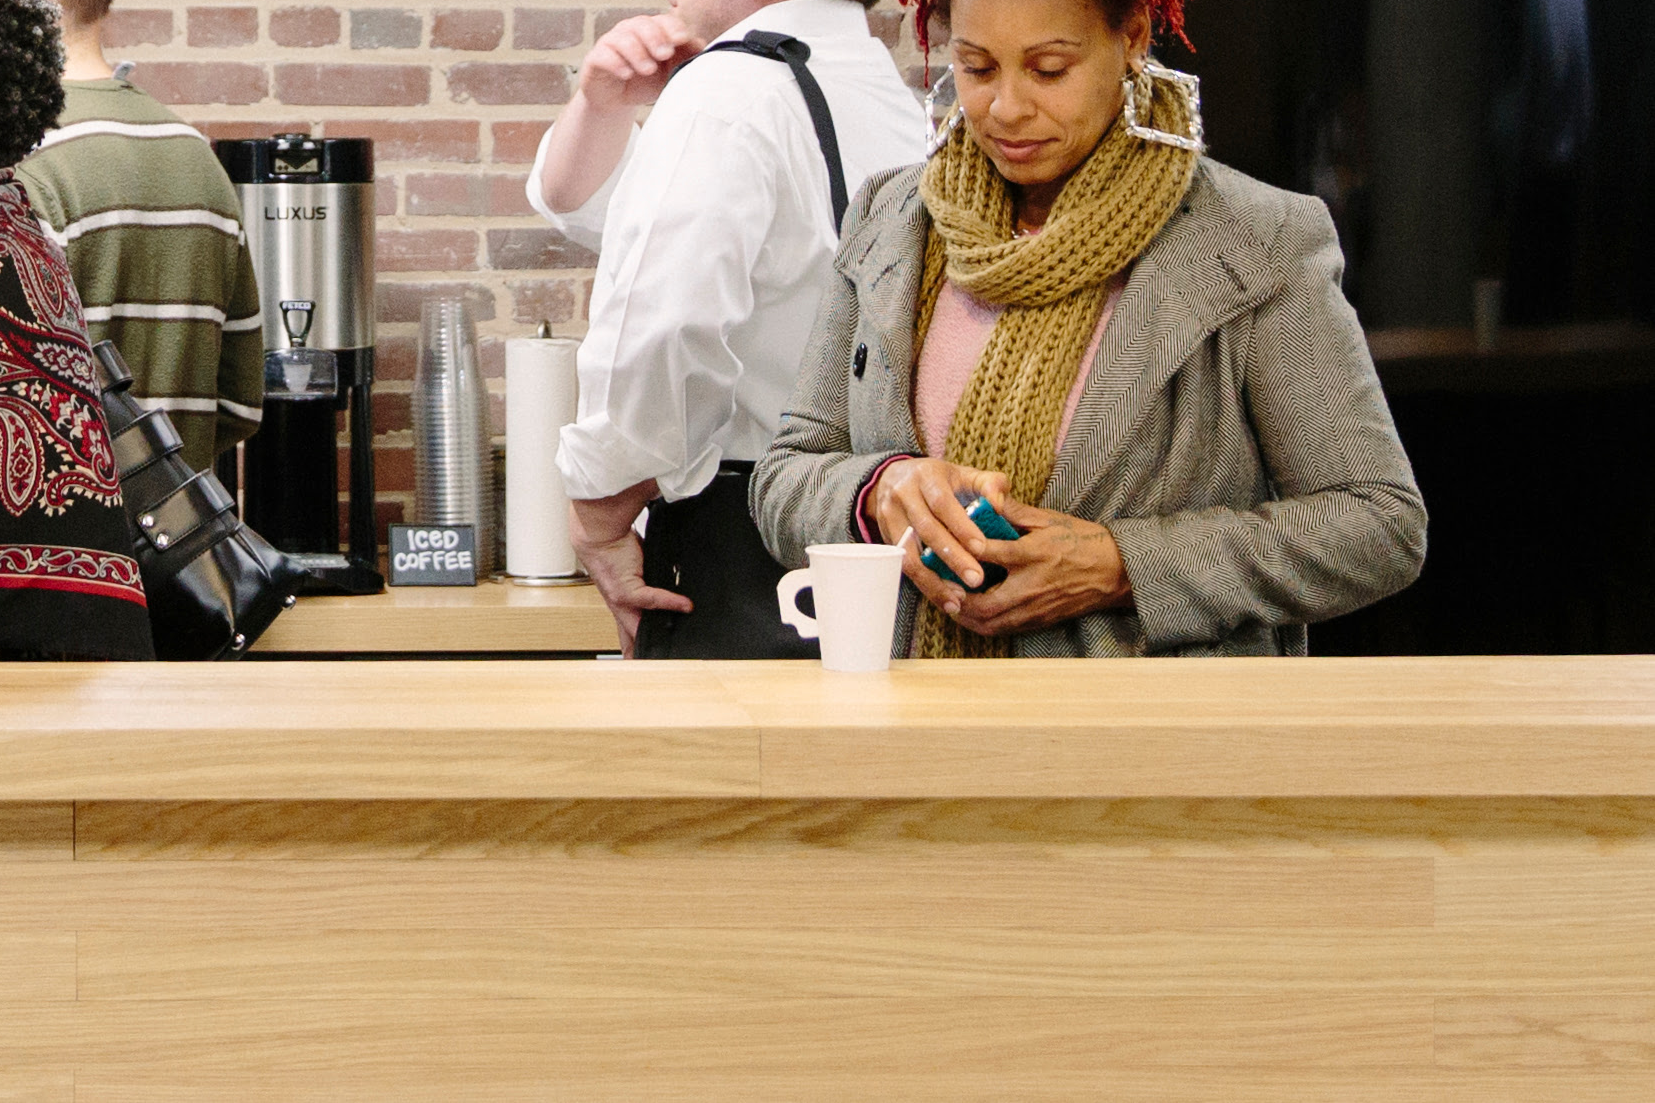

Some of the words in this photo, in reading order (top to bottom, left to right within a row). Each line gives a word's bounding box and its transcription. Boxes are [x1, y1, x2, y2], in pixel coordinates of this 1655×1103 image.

[264, 206, 328, 220] LUXUS
[282, 301, 312, 310] FETCO
[394, 551, 473, 572] COFFEE
